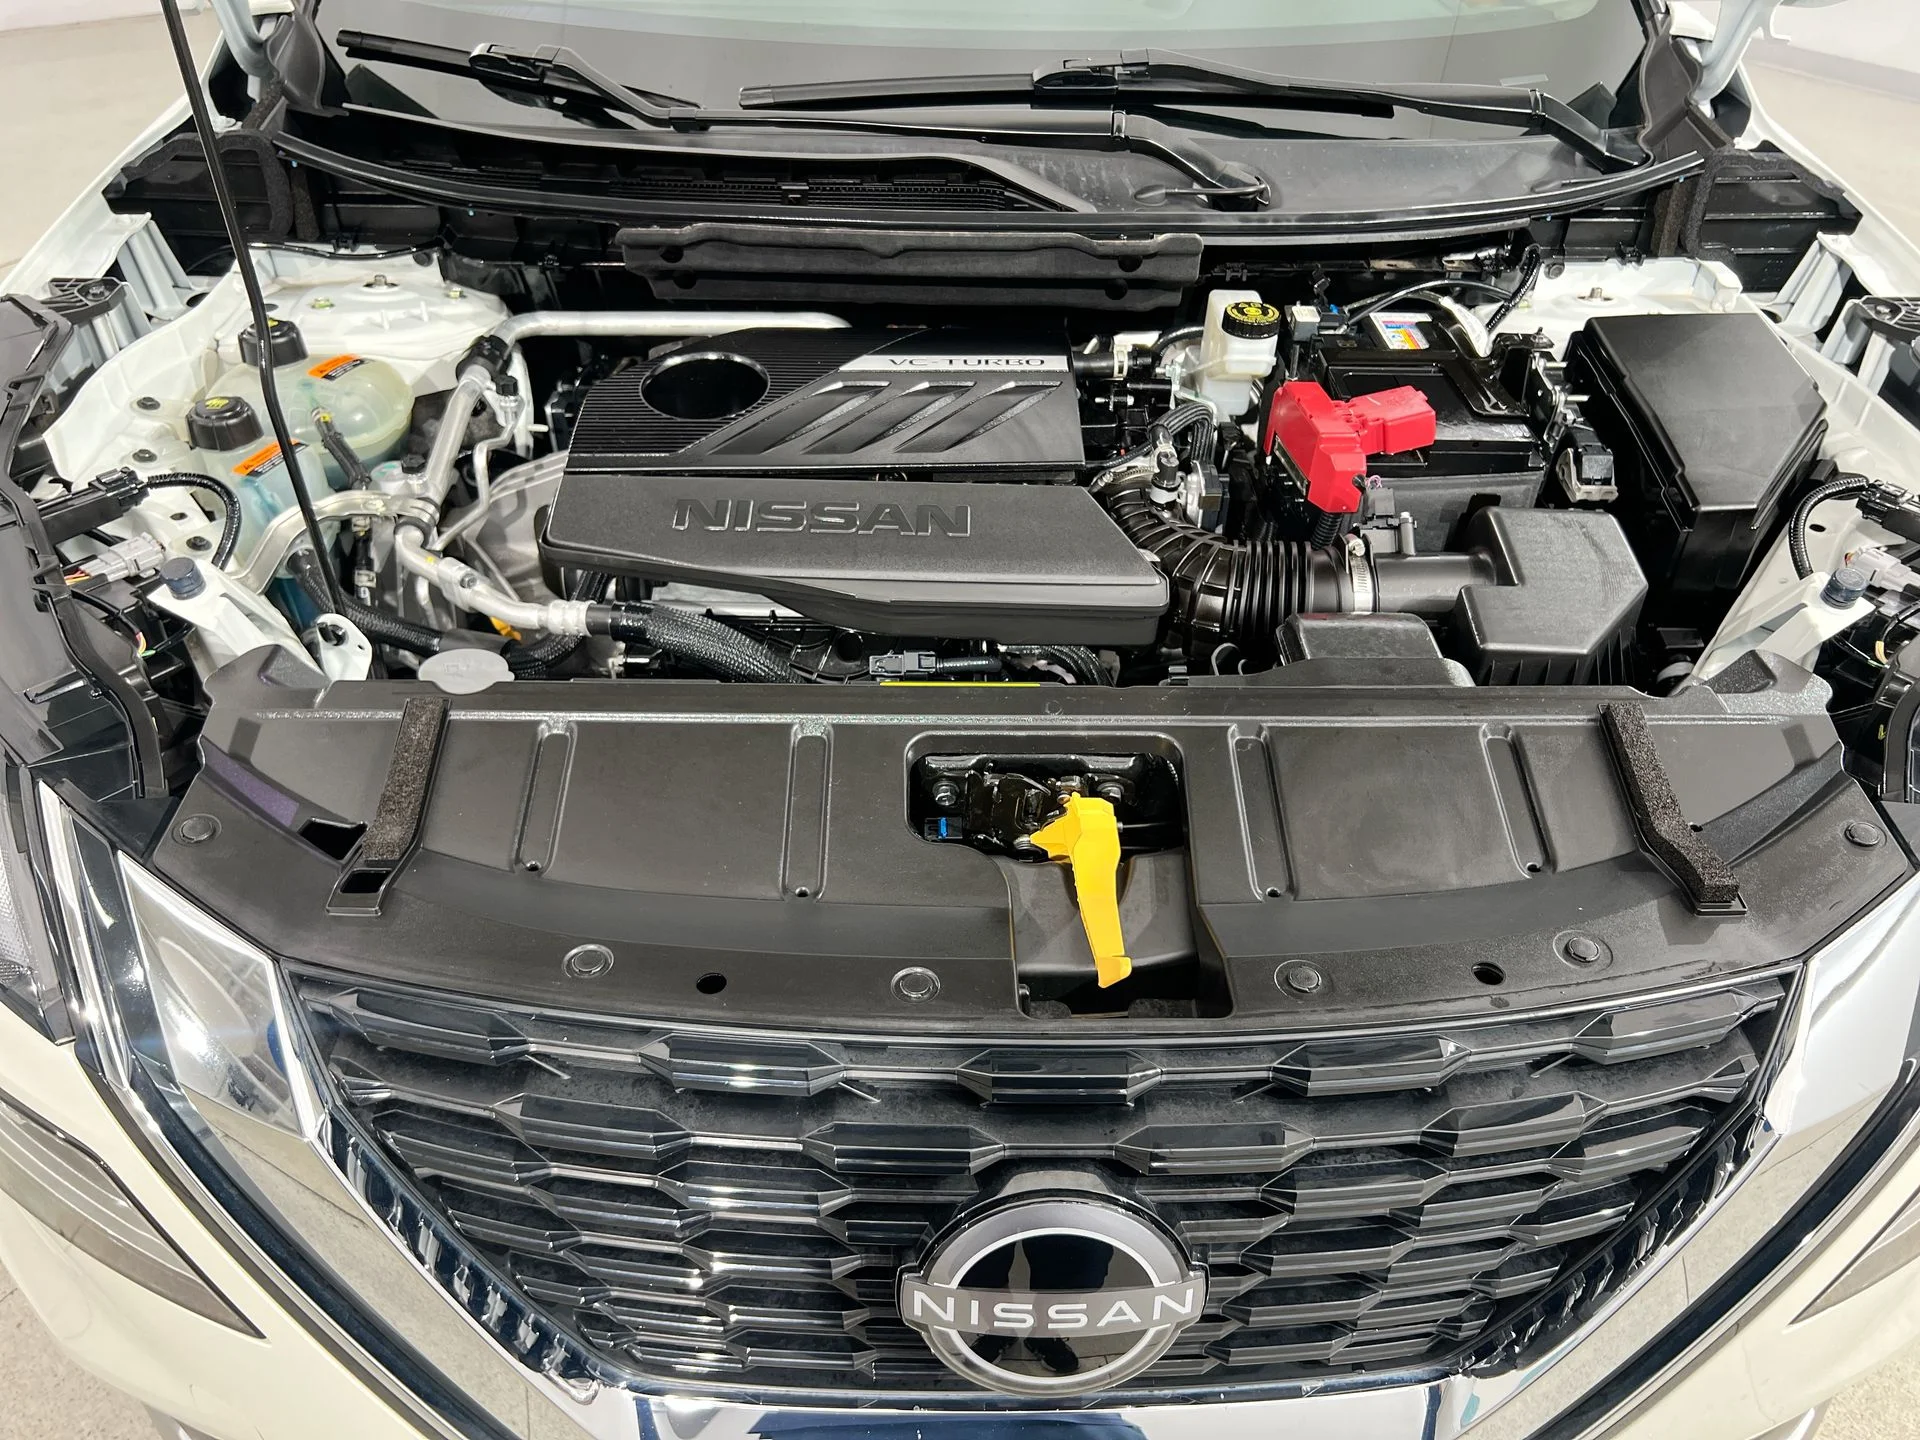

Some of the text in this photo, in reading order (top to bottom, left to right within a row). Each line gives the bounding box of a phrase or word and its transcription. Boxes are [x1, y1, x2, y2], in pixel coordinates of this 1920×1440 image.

[888, 357, 1046, 367] VC-TURBO
[671, 498, 971, 537] NISSAN
[912, 1287, 1195, 1330] NISSAN
